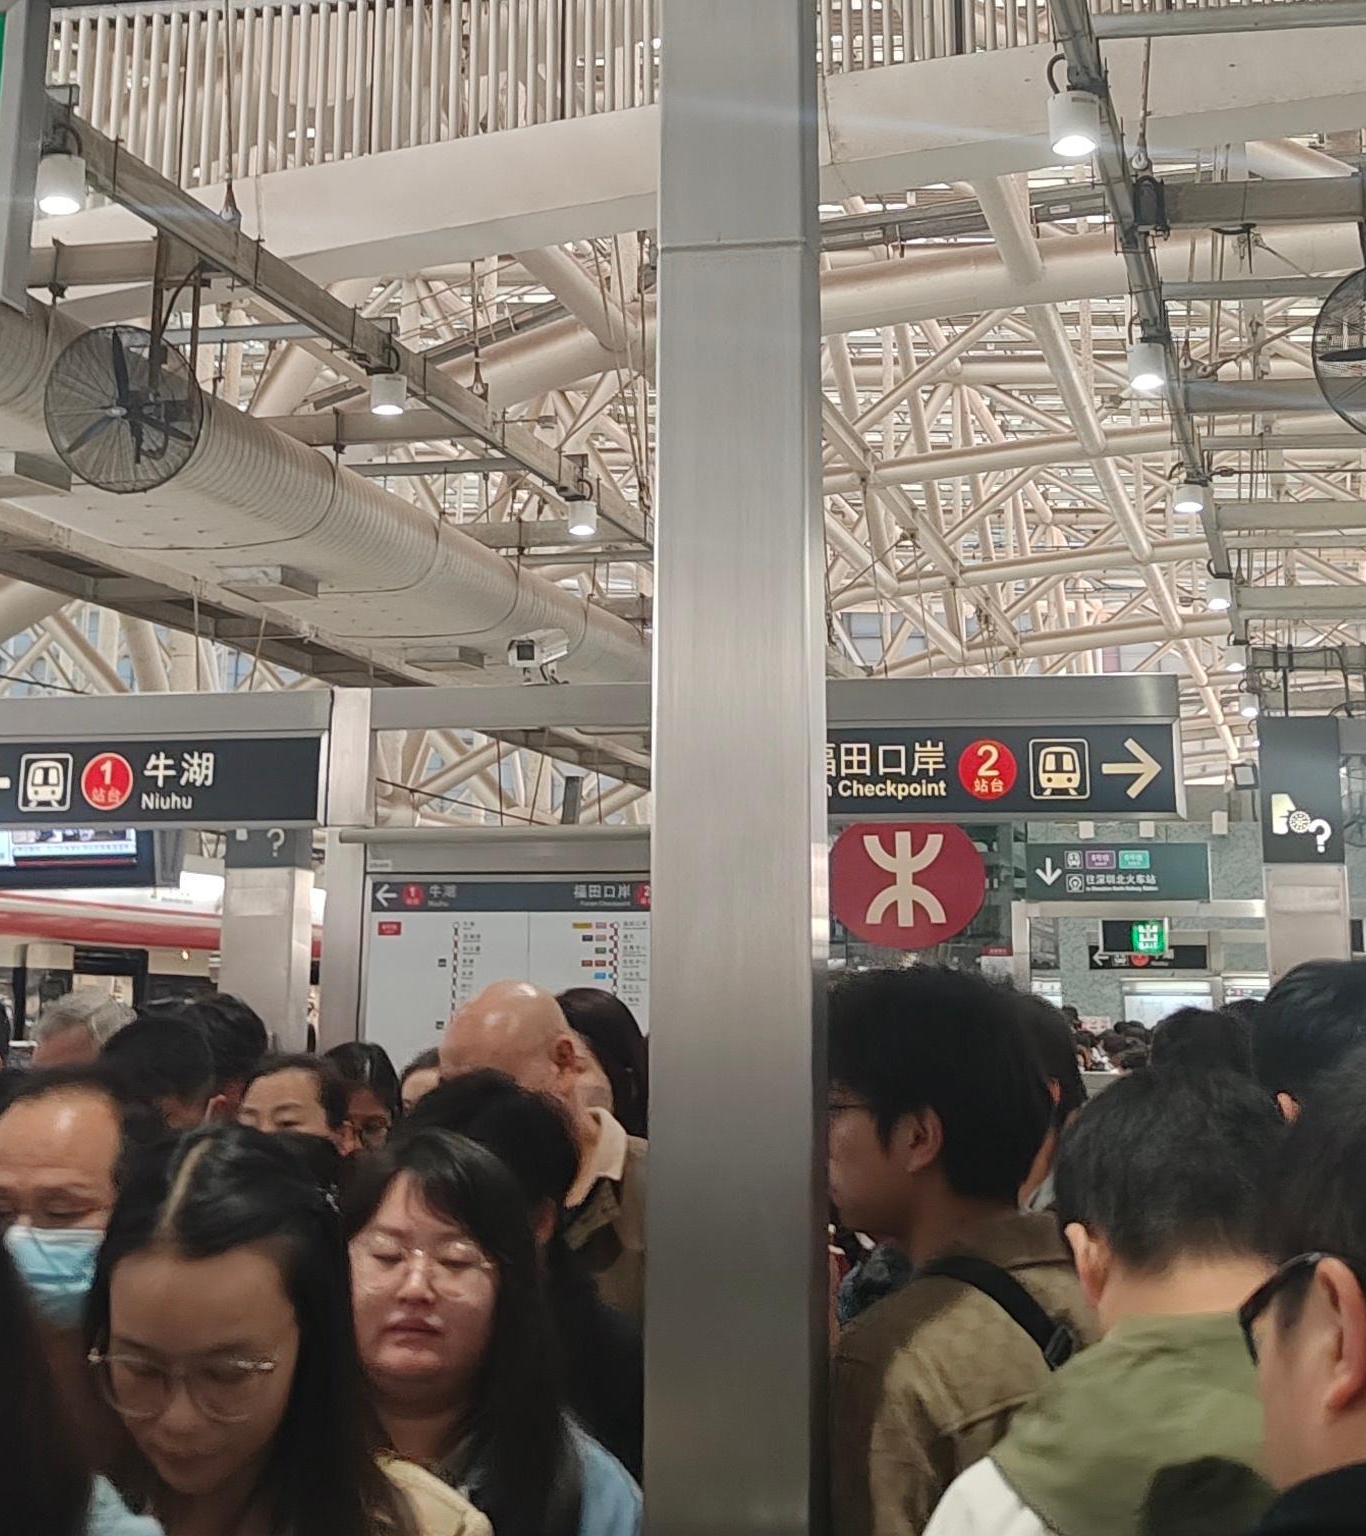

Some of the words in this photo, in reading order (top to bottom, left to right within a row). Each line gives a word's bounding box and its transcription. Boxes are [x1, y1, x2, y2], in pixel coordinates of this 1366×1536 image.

[143, 751, 215, 789] 牛湖
[976, 744, 1002, 778] 2
[99, 760, 113, 786] 1
[838, 779, 948, 800] Checkpoint
[973, 778, 1005, 794] 站台
[141, 791, 194, 811] Niuhu
[410, 886, 416, 897] 1
[574, 884, 631, 899] 福田口岸
